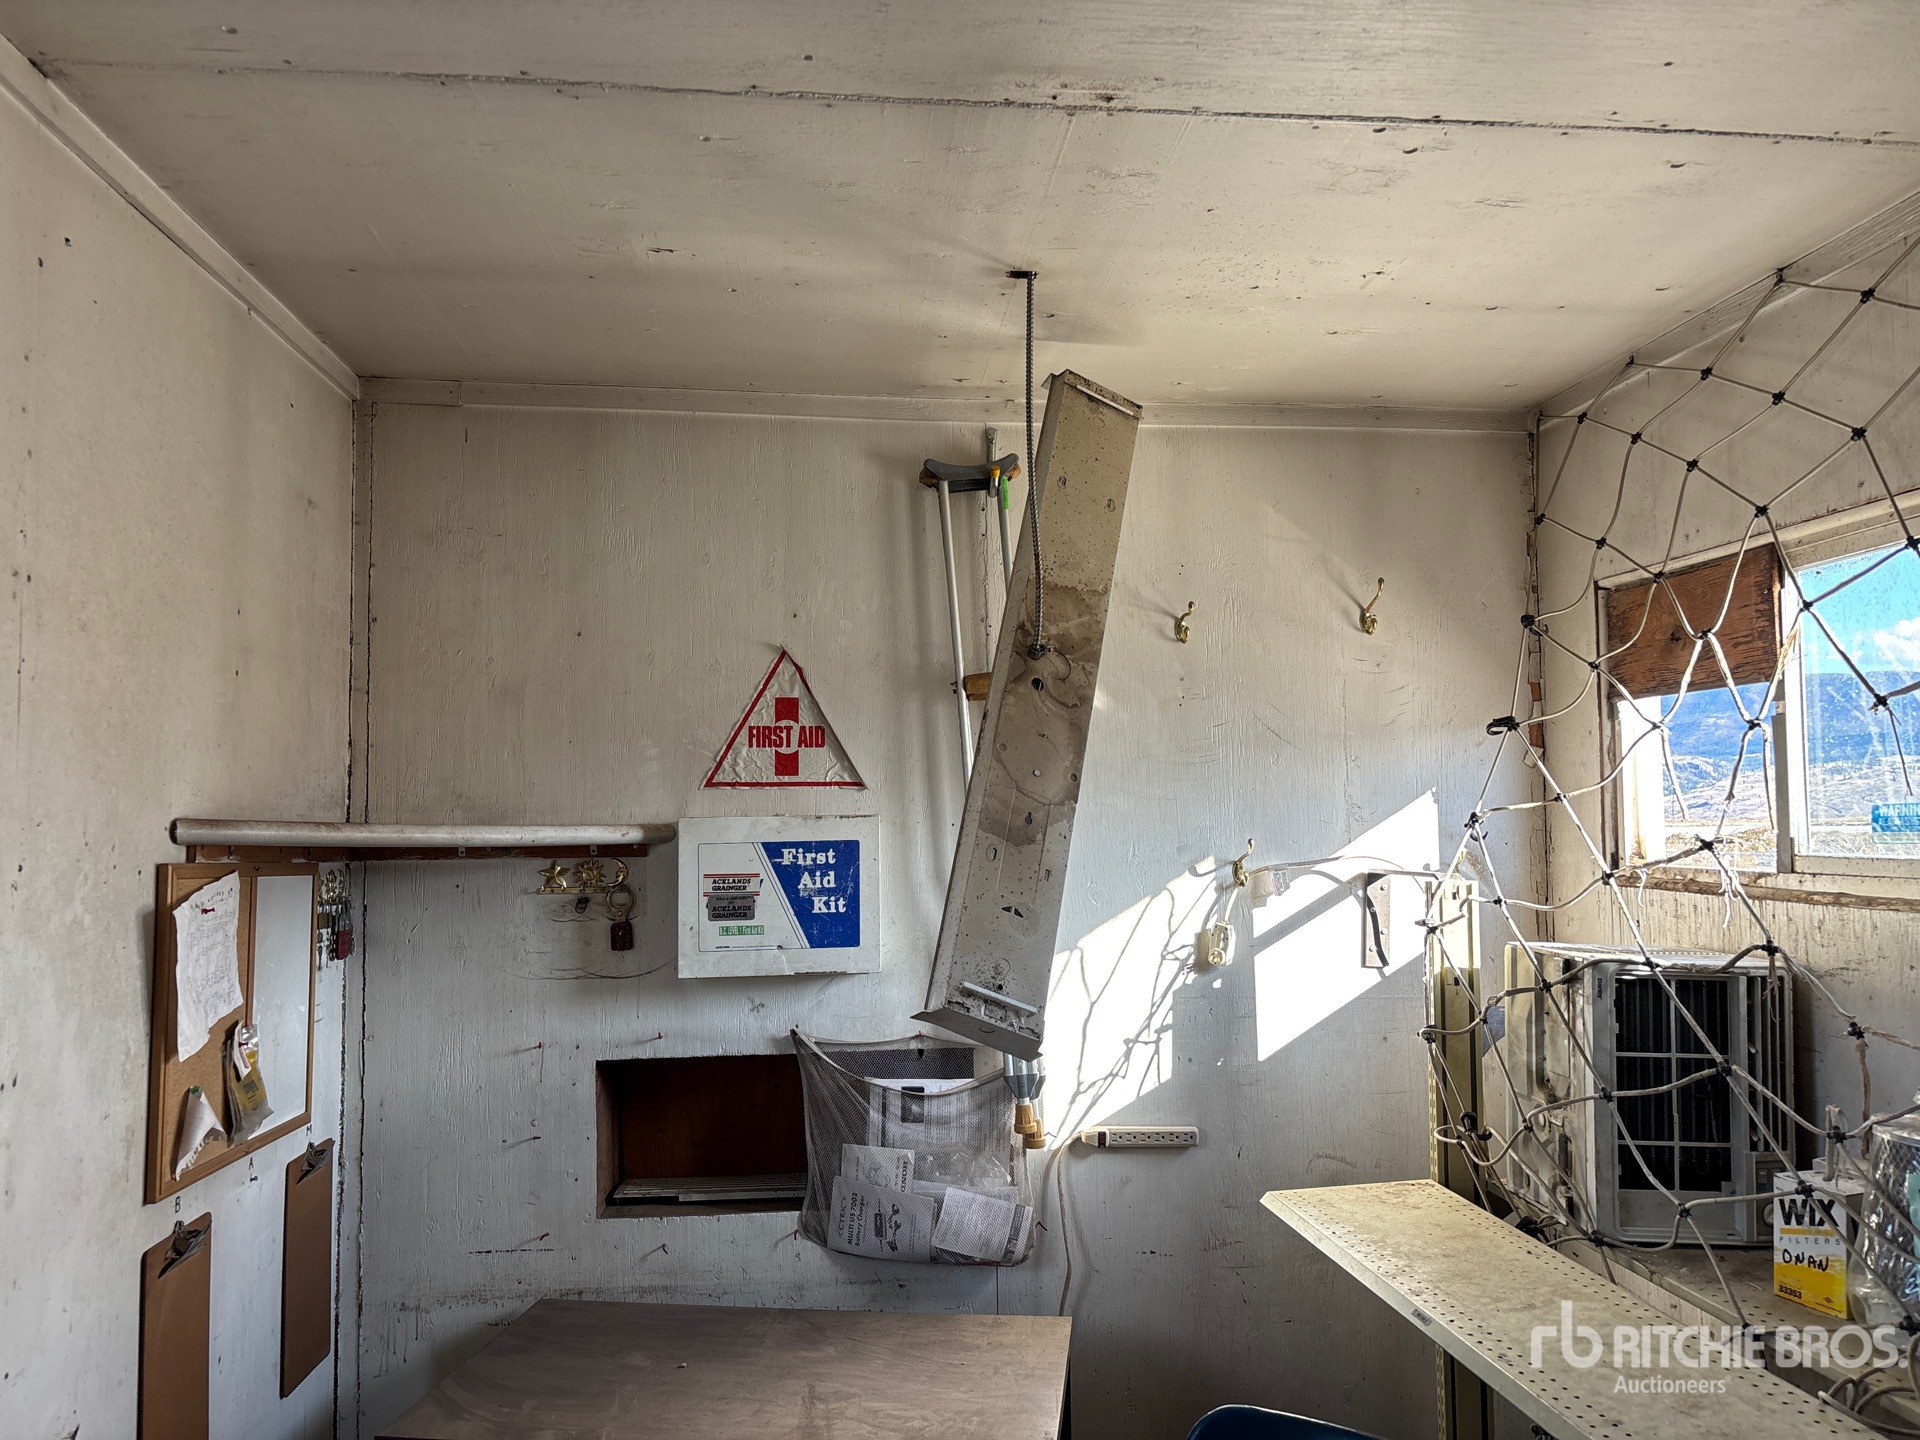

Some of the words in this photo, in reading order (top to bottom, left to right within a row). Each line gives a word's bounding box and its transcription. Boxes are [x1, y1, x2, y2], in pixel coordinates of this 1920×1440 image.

[748, 726, 793, 748] FIRST
[797, 726, 825, 748] AID
[781, 848, 836, 865] First
[798, 871, 836, 888] Aid
[812, 897, 846, 913] Kit
[248, 1157, 254, 1170] A
[174, 1196, 181, 1213] B
[1778, 1198, 1839, 1227] WIX
[854, 1224, 863, 1247] Battery
[1779, 1236, 1841, 1245] FILTERS
[1782, 1248, 1829, 1272] ONAN
[1778, 1284, 1803, 1300] 33353
